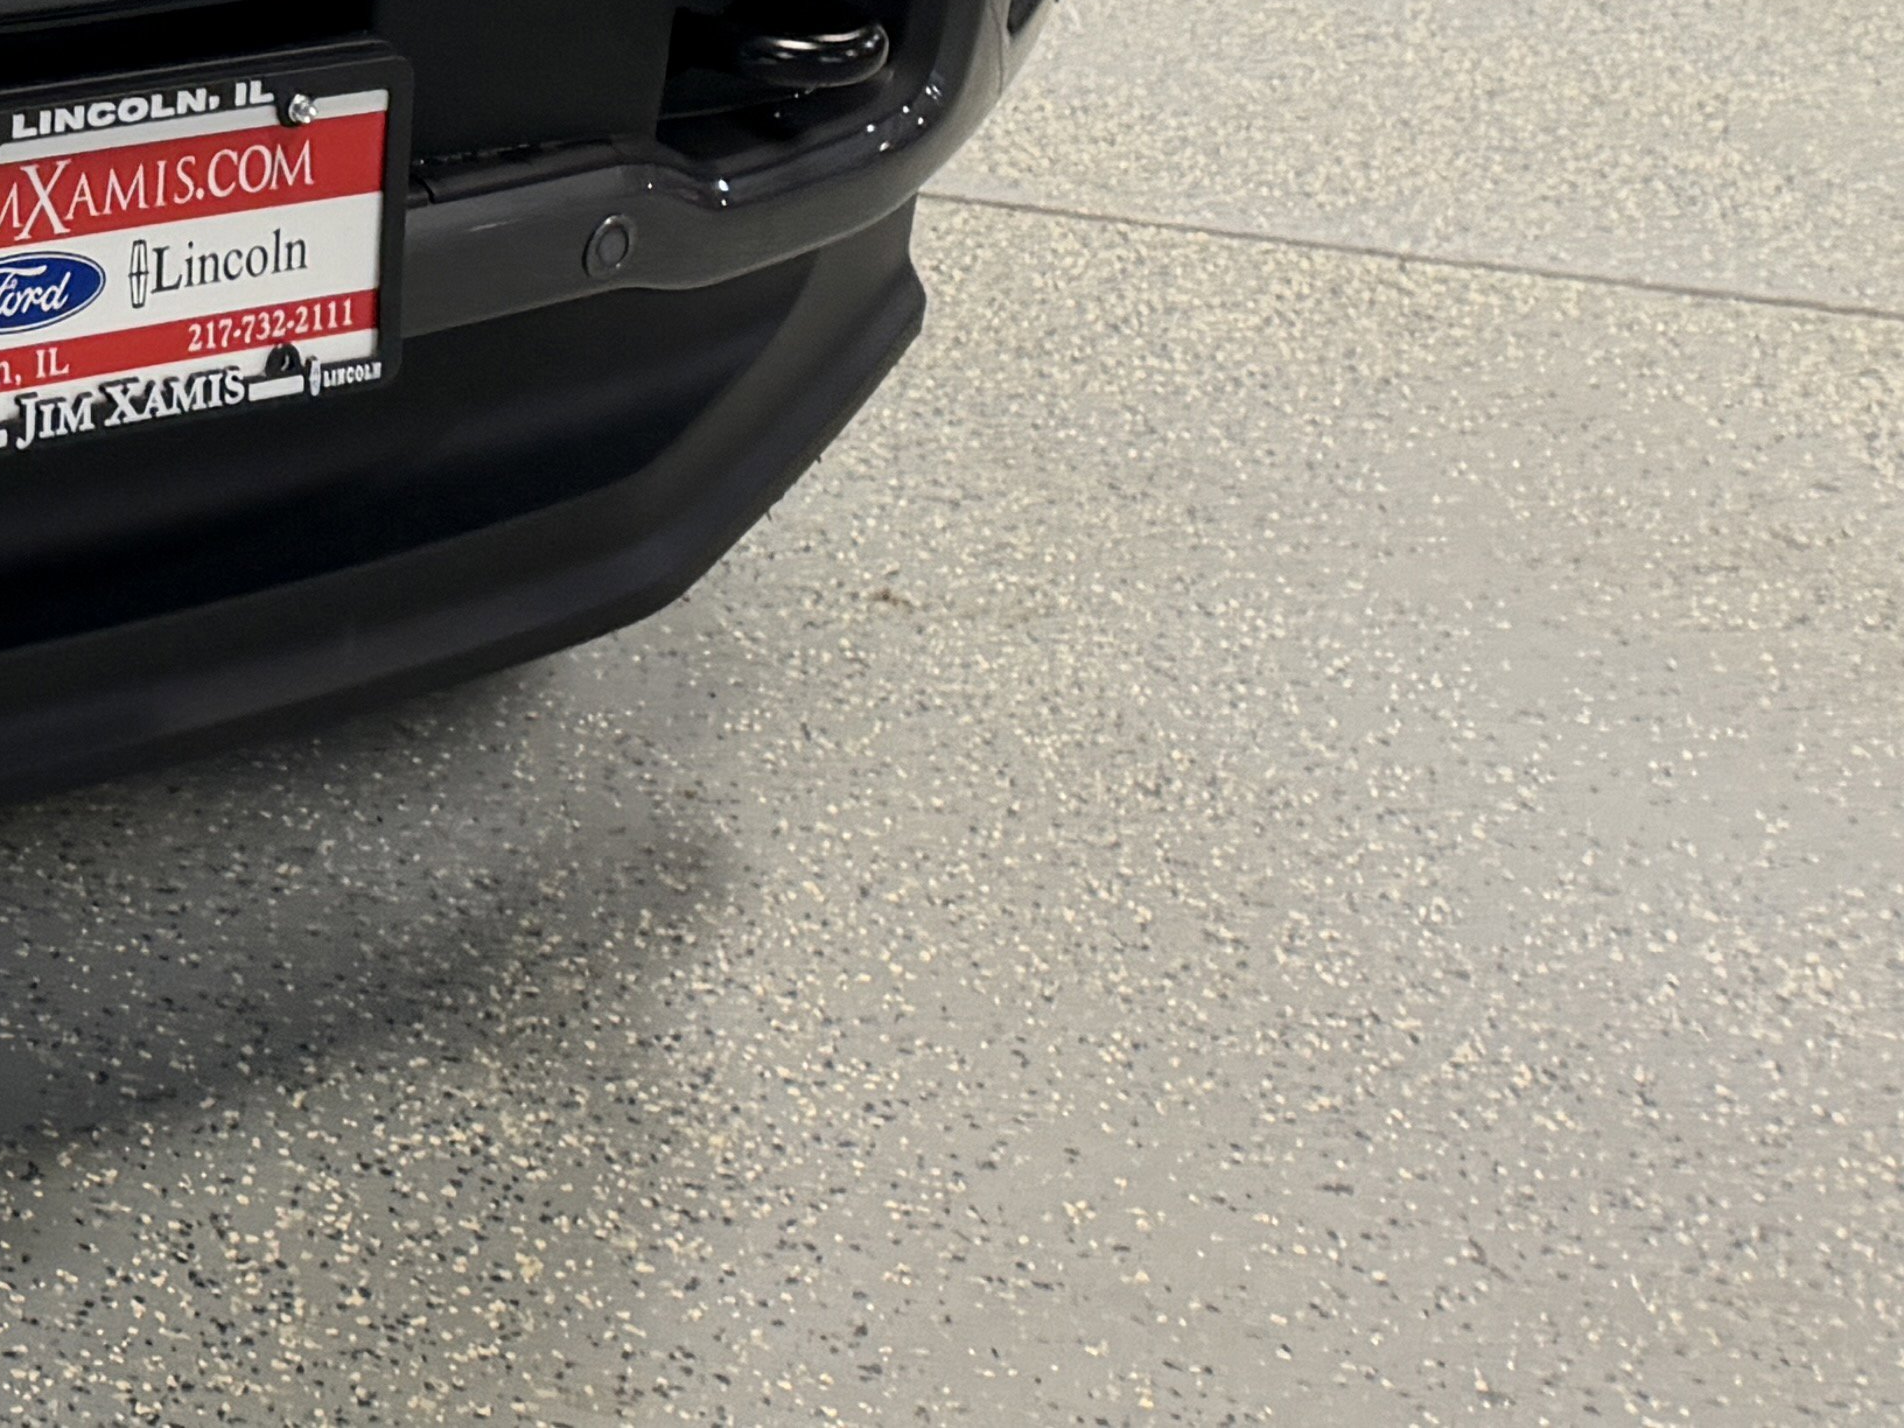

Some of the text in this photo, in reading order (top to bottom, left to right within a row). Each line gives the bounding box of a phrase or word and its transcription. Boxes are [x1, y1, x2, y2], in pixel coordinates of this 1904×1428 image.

[12, 80, 275, 139] LINCOLN, IL
[150, 229, 309, 295] Lincoln
[188, 298, 354, 352] 217-732-2111
[35, 347, 70, 378] IL
[323, 361, 382, 388] LINCOLN
[16, 368, 245, 449] JIM XAMIS
